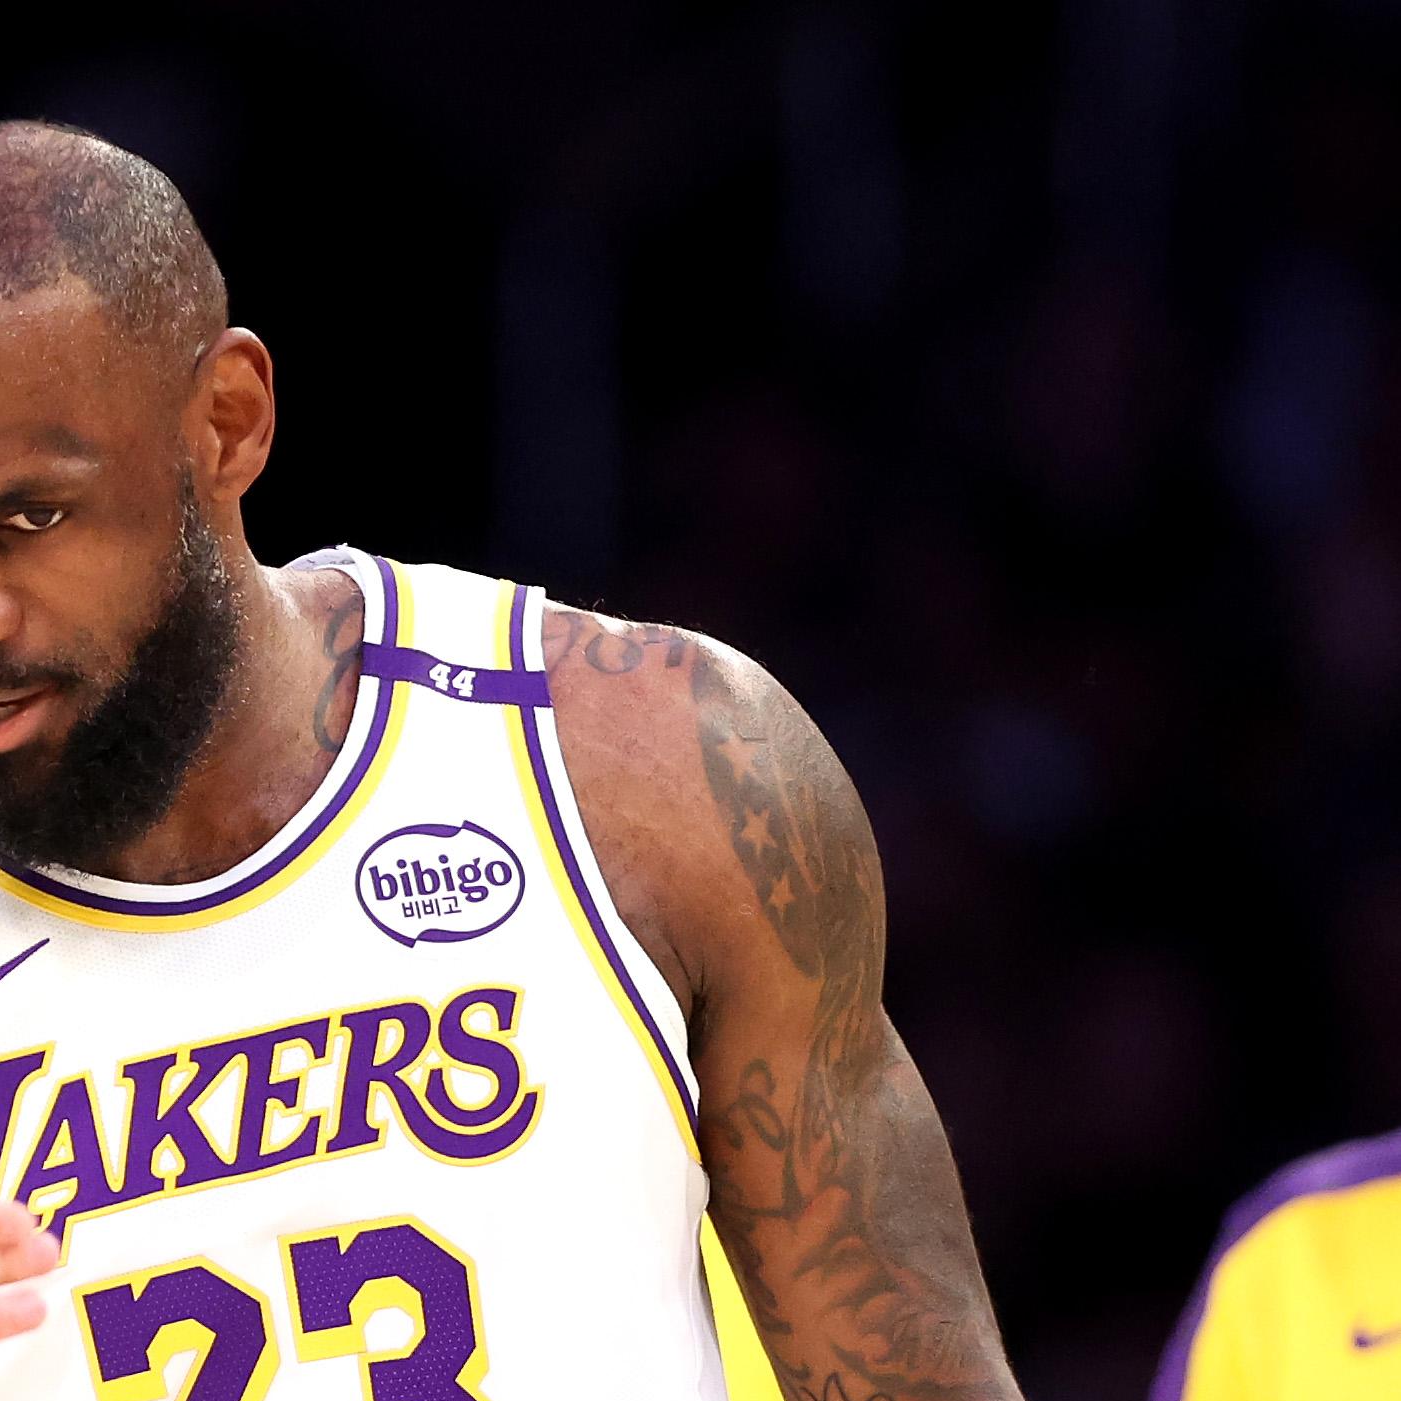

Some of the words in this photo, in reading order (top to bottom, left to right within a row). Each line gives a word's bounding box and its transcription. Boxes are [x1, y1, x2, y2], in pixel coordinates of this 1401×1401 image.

[429, 662, 476, 698] 44
[368, 854, 513, 903] bibigo
[401, 895, 462, 919] 비비고
